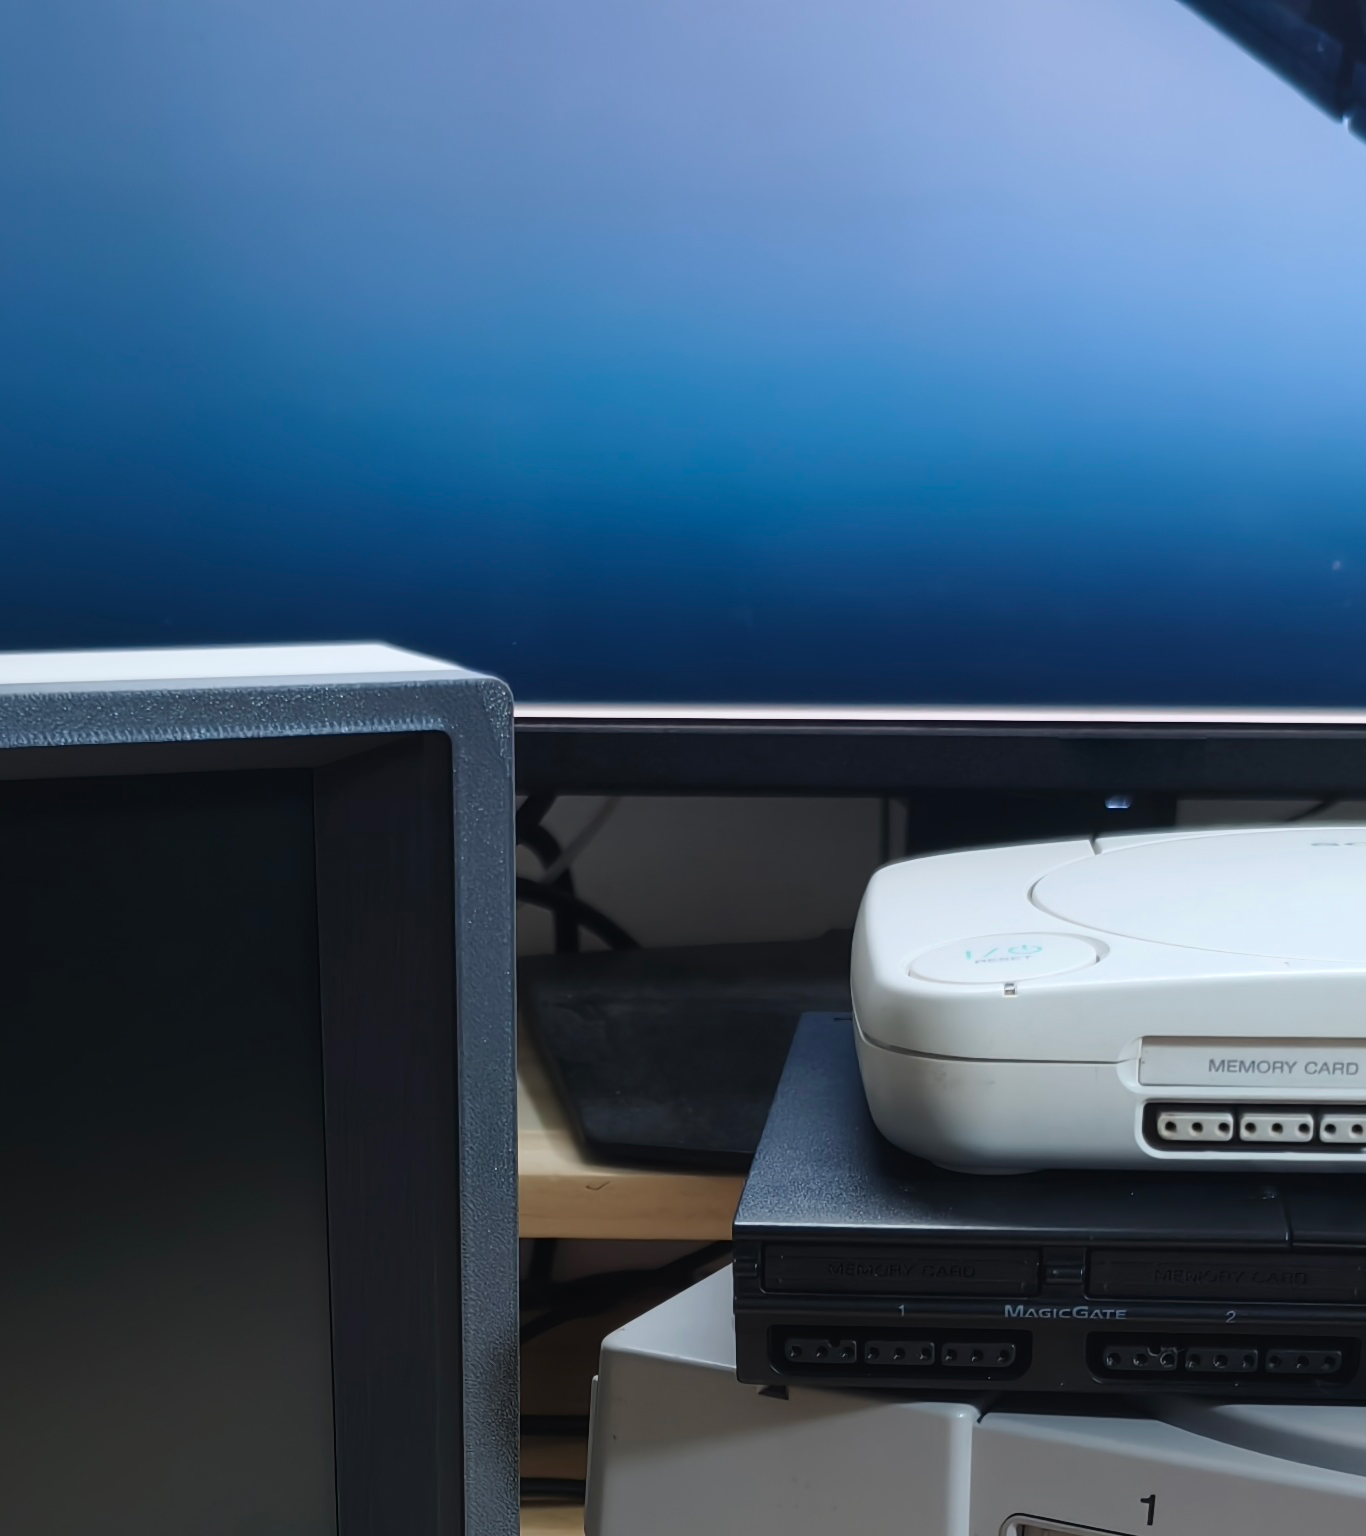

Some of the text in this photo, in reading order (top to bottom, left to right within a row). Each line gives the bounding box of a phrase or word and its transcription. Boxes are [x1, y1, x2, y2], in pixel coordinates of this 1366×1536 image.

[1208, 1058, 1359, 1076] MEMORY CARD
[827, 1263, 976, 1279] MEMORY CARD
[1154, 1268, 1246, 1284] MEMORY
[897, 1304, 906, 1317] 1
[1224, 1310, 1237, 1324] 2
[1140, 1494, 1156, 1526] 1
